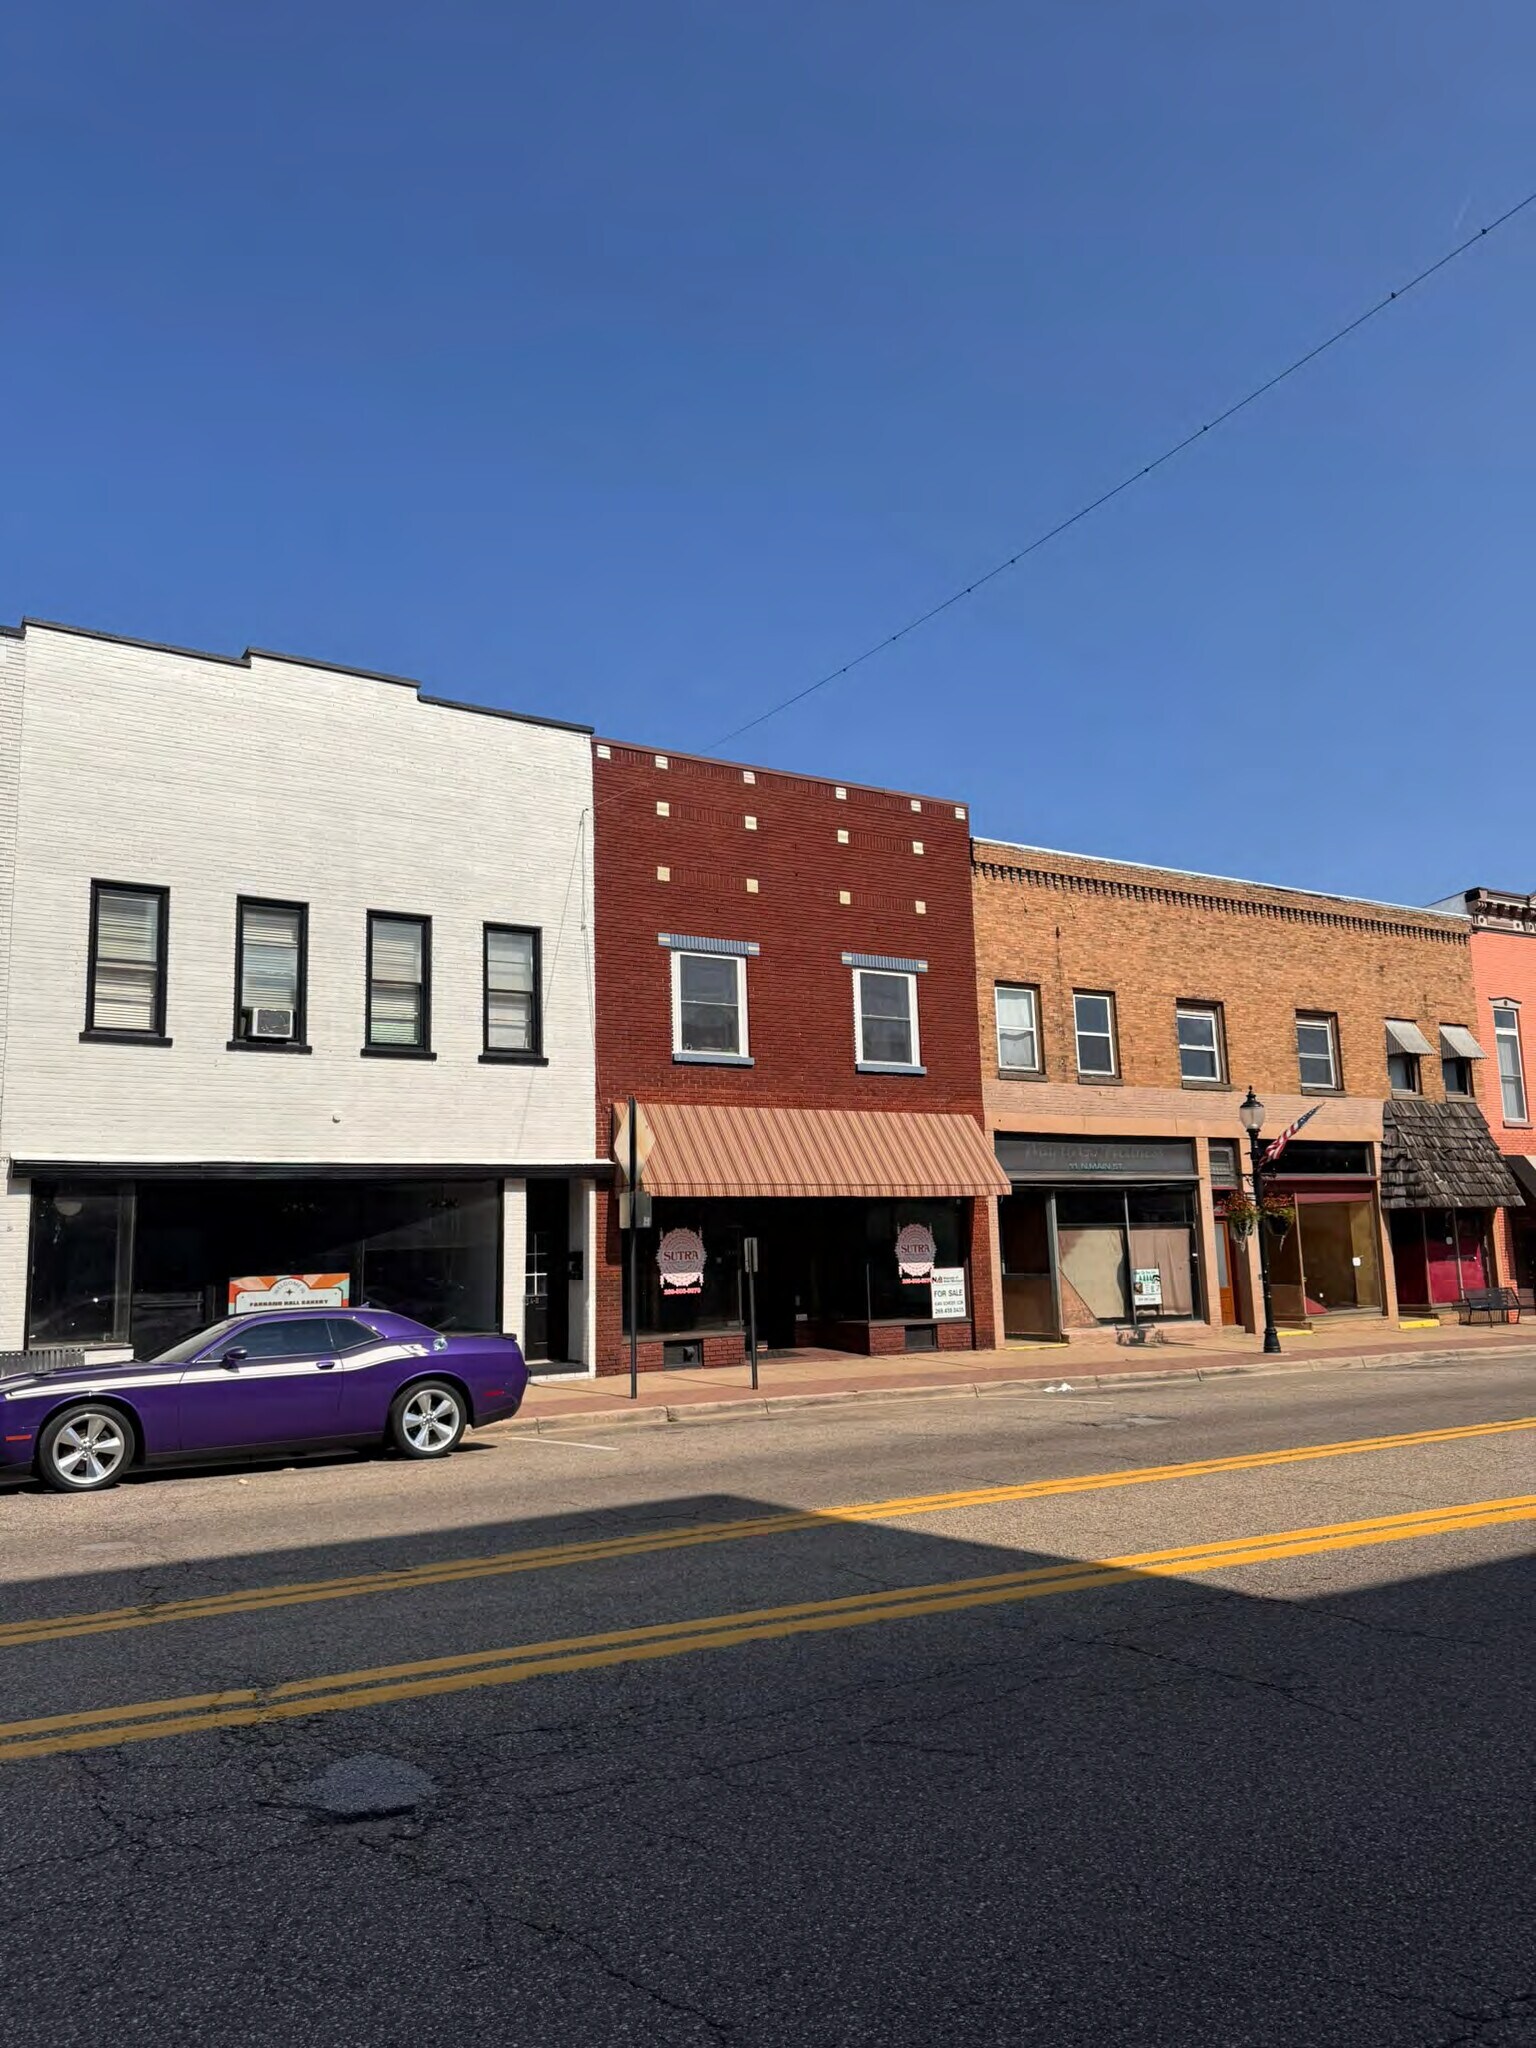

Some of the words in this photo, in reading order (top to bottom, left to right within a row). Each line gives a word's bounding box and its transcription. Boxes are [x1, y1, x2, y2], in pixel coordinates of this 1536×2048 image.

[901, 1244, 930, 1254] SUTRA
[663, 1250, 699, 1261] SUTRA
[934, 1290, 947, 1298] FOR
[948, 1289, 963, 1297] SALE
